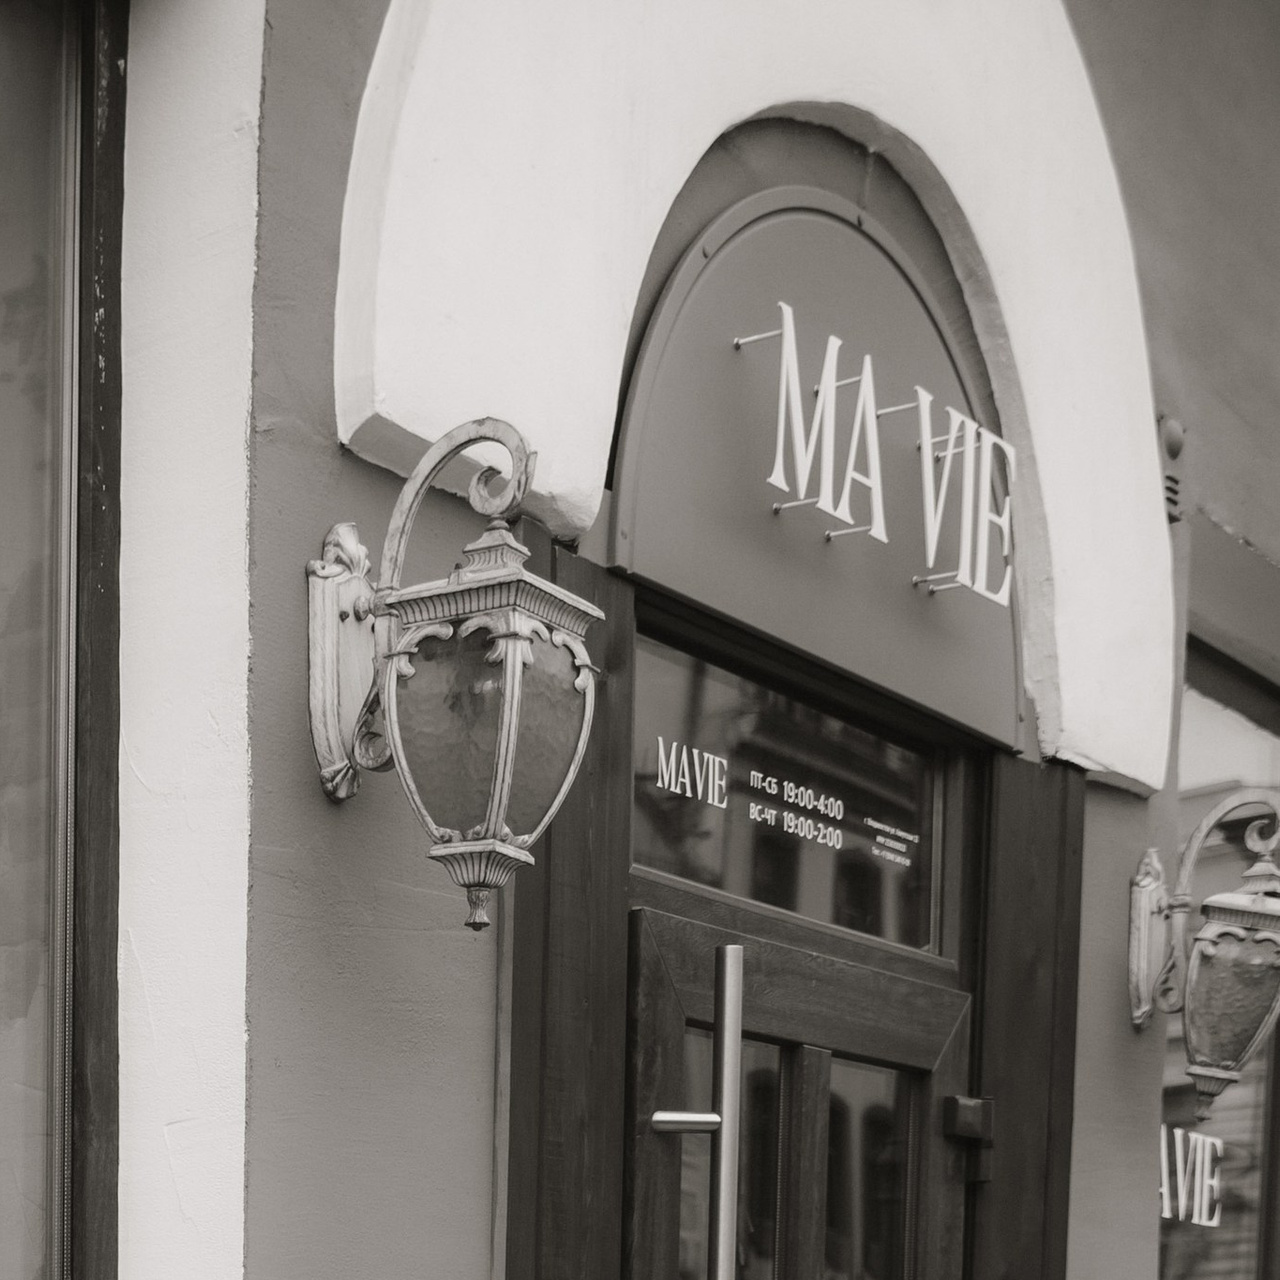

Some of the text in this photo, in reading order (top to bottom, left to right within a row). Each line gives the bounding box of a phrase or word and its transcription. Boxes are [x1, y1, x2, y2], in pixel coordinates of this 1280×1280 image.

[766, 301, 1016, 607] MA VIE
[782, 781, 844, 820] 19:00-4:00
[782, 811, 843, 849] 19:00-2:00
